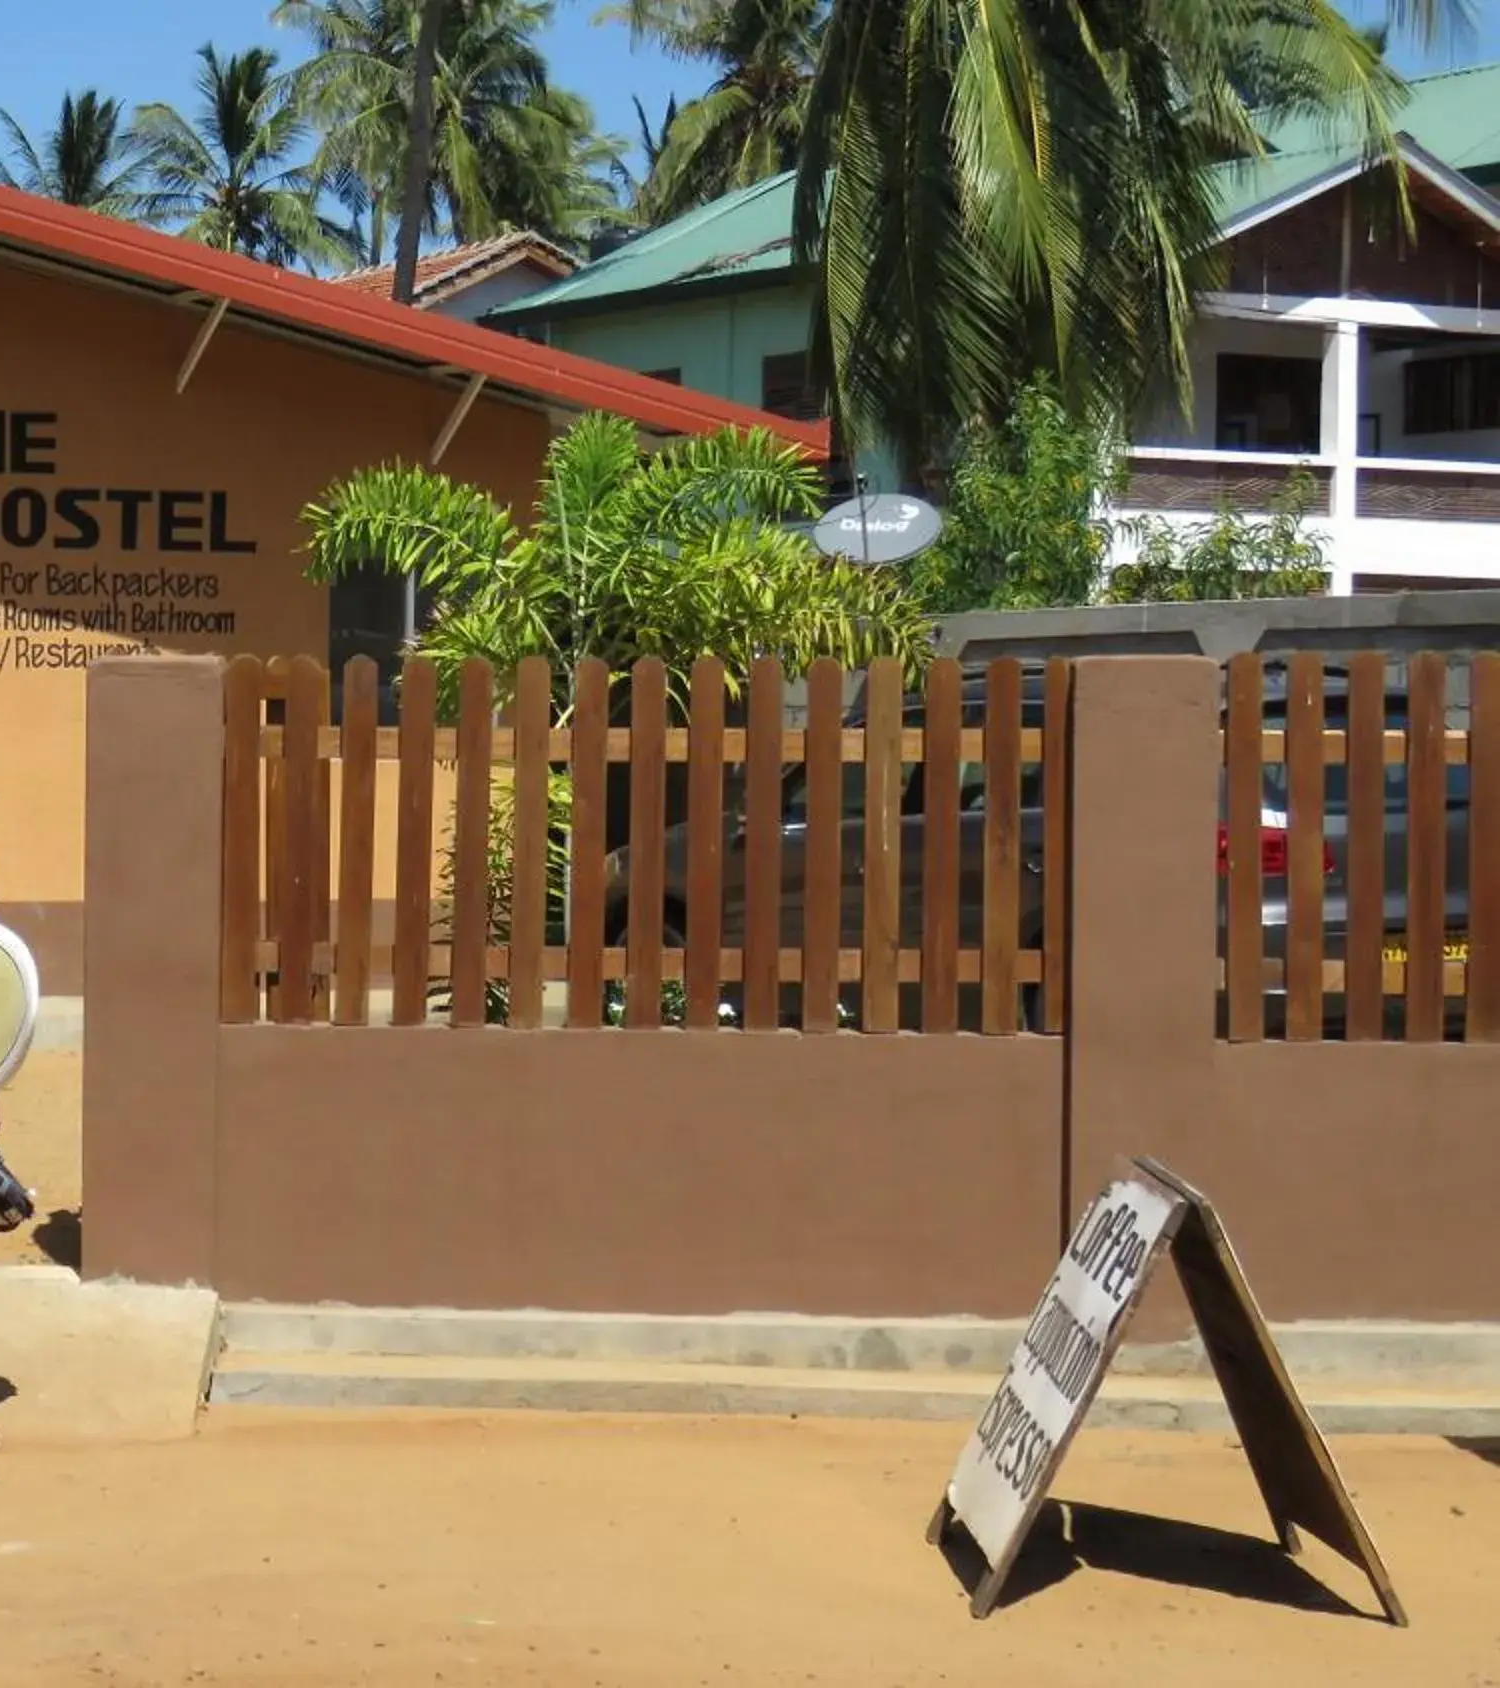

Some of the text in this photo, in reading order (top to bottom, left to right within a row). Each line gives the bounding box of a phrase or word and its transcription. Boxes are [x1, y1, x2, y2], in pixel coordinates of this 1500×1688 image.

[840, 518, 911, 533] Dialog
[3, 600, 76, 632] Rooms
[80, 601, 125, 632] with
[132, 602, 235, 633] Bathroom
